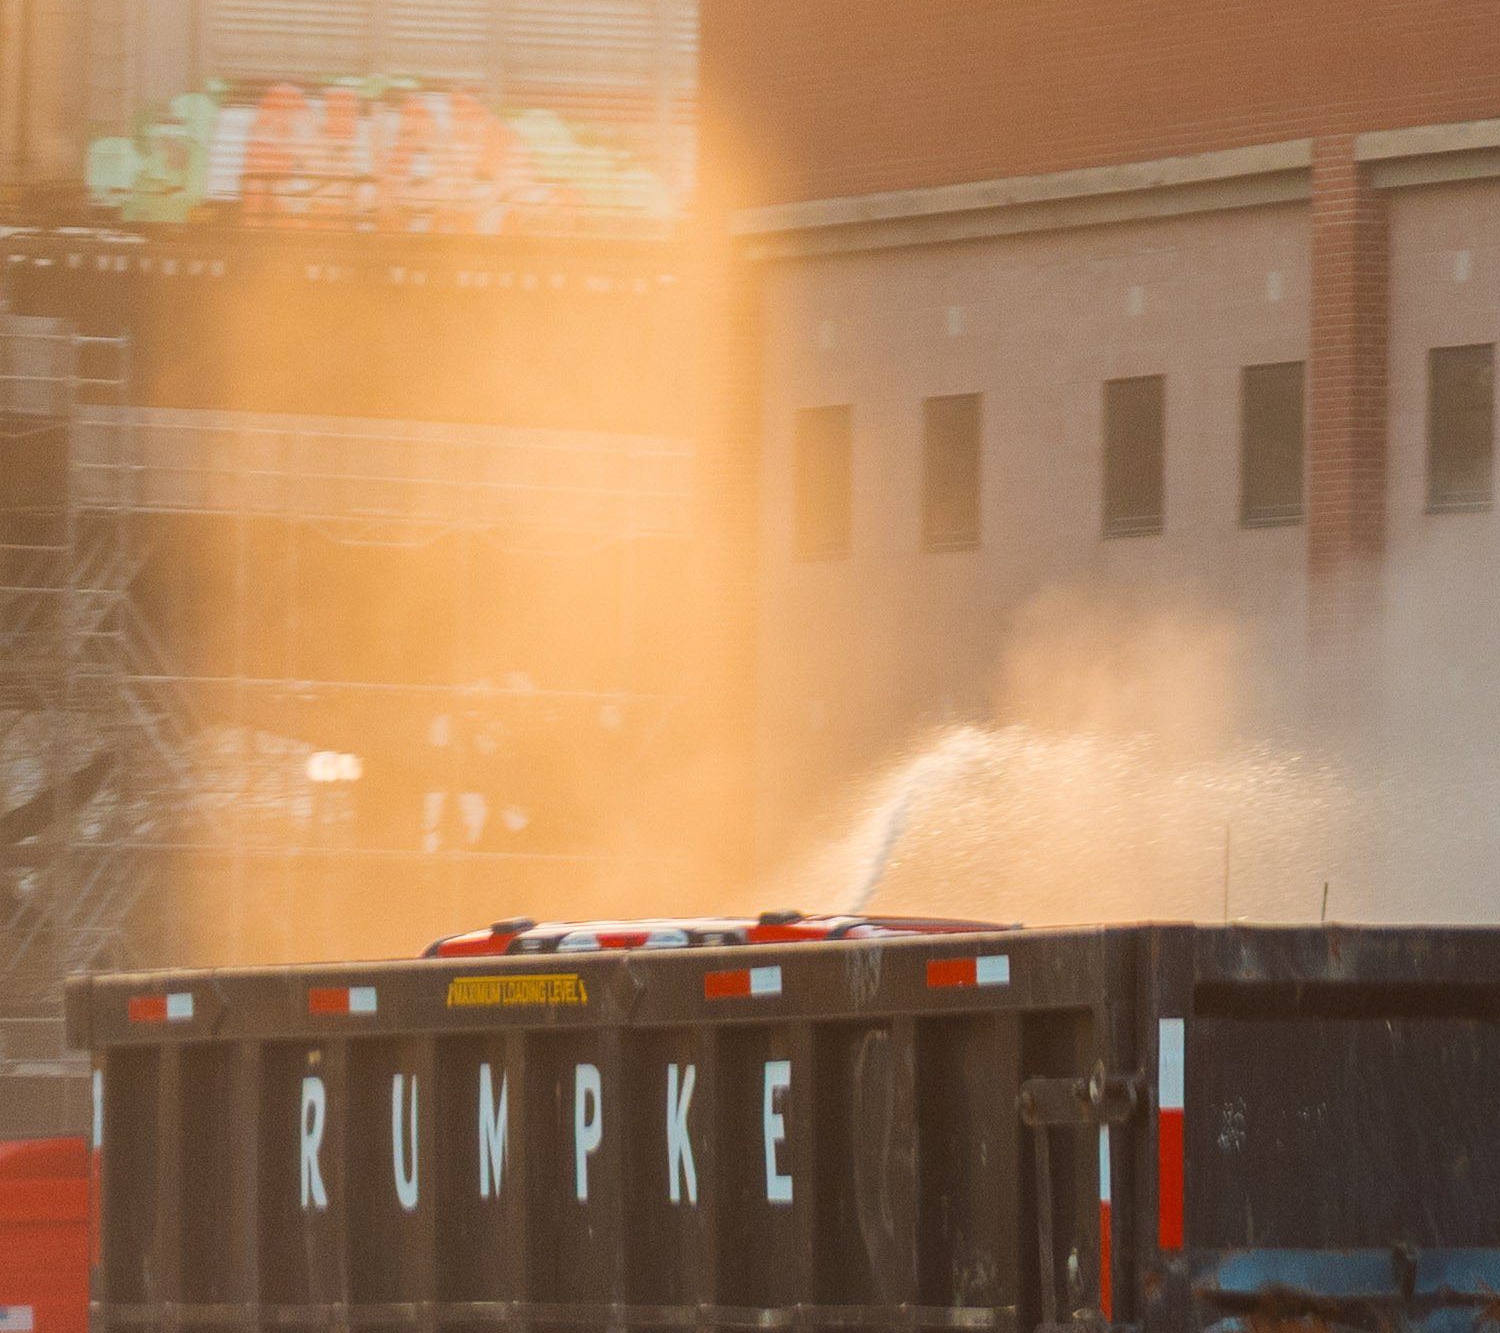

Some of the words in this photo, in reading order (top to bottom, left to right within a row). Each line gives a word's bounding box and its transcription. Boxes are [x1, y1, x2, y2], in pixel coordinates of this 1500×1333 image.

[502, 982, 546, 1002] LOADING
[547, 980, 579, 1001] LEVEL
[301, 1061, 794, 1209] RUMPKE
